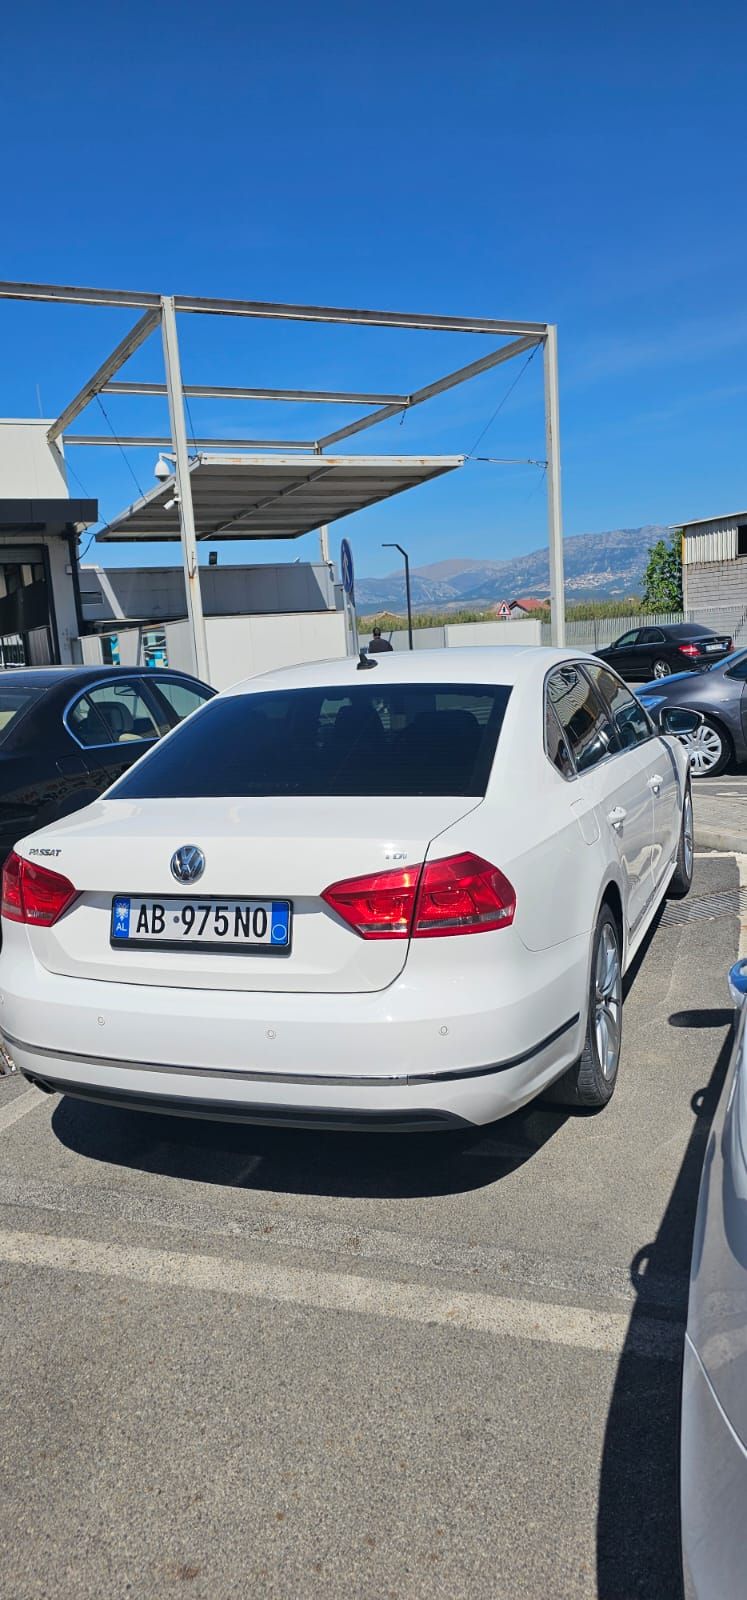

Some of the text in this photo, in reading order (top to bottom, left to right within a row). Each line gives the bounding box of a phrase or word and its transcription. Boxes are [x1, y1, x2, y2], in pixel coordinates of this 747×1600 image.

[29, 848, 62, 857] PASSAT
[136, 904, 166, 934] AB
[115, 922, 127, 932] AL
